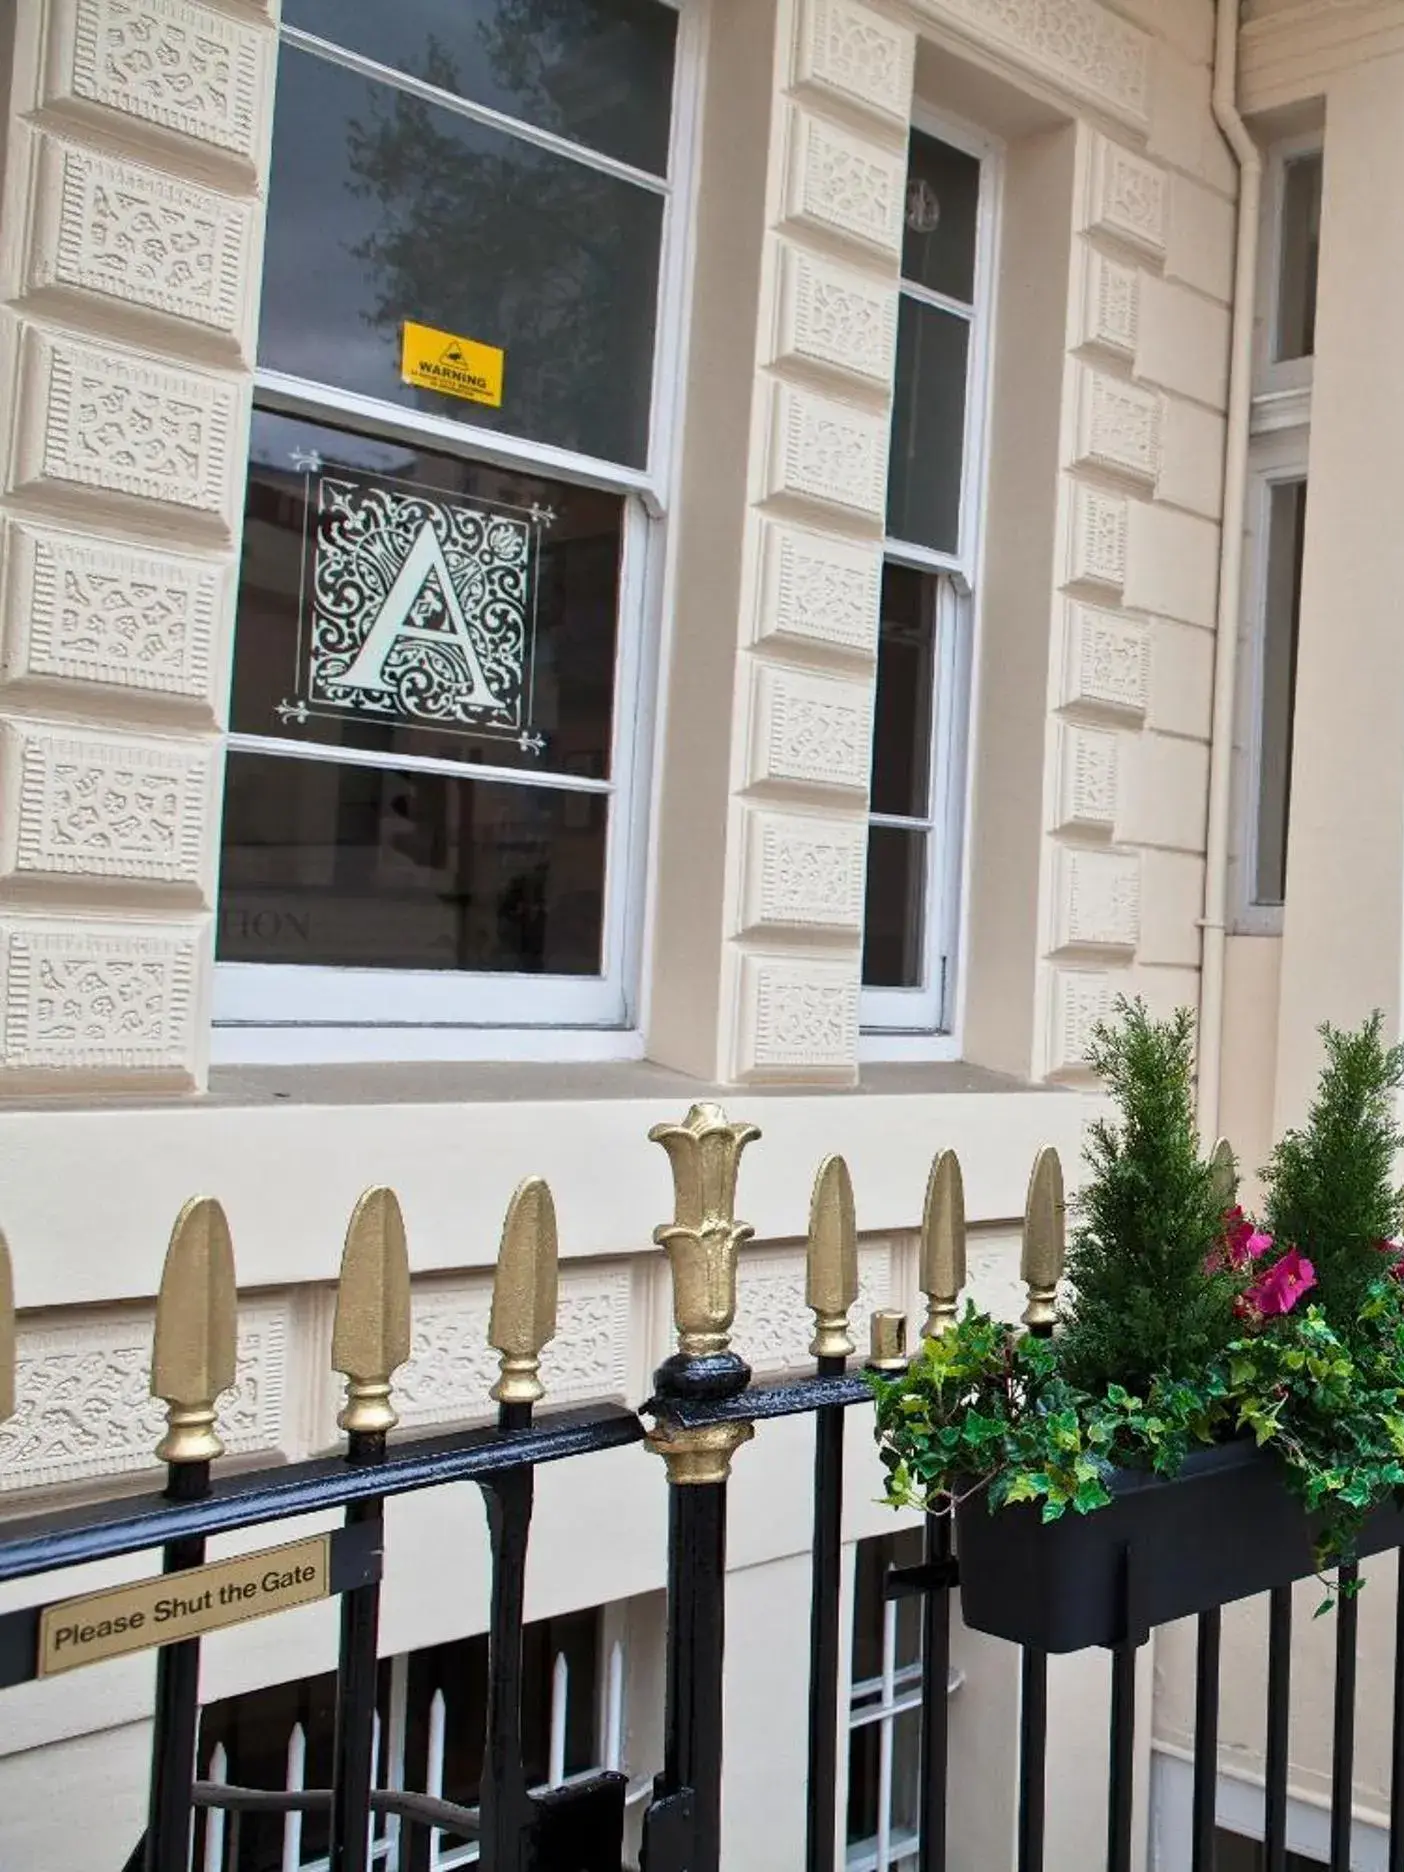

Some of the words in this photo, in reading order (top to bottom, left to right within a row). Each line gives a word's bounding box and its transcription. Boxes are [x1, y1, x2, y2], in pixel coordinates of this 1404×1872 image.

[418, 360, 487, 389] WARNING
[327, 519, 506, 708] A
[54, 1611, 146, 1651] Please
[153, 1592, 213, 1624] Shut
[219, 1581, 257, 1606] the
[260, 1563, 316, 1592] Gate
